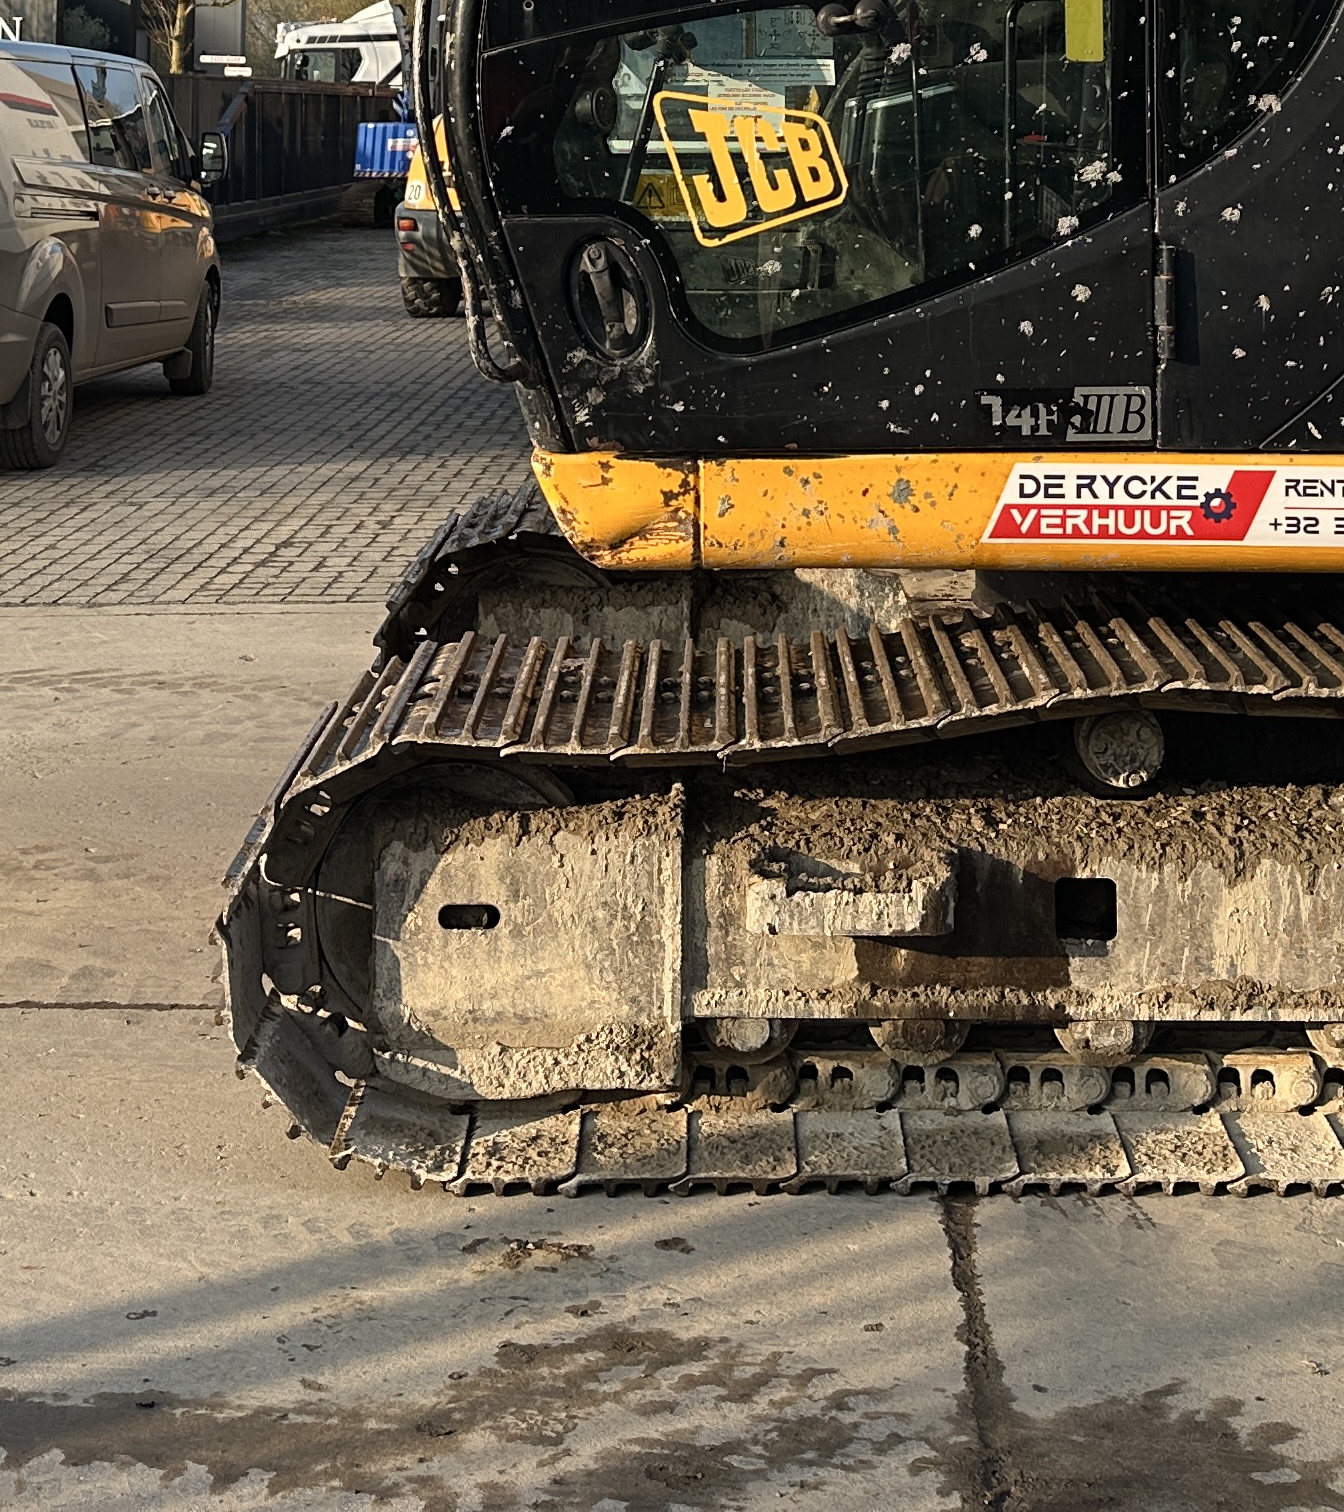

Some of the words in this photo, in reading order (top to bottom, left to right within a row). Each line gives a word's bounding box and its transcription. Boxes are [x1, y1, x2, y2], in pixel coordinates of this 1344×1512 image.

[687, 108, 835, 228] JCB
[408, 185, 422, 200] 20
[1019, 474, 1065, 498] DE
[1076, 475, 1199, 500] RYCKE
[1010, 508, 1194, 536] VERHUUR
[1269, 516, 1320, 534] +32
